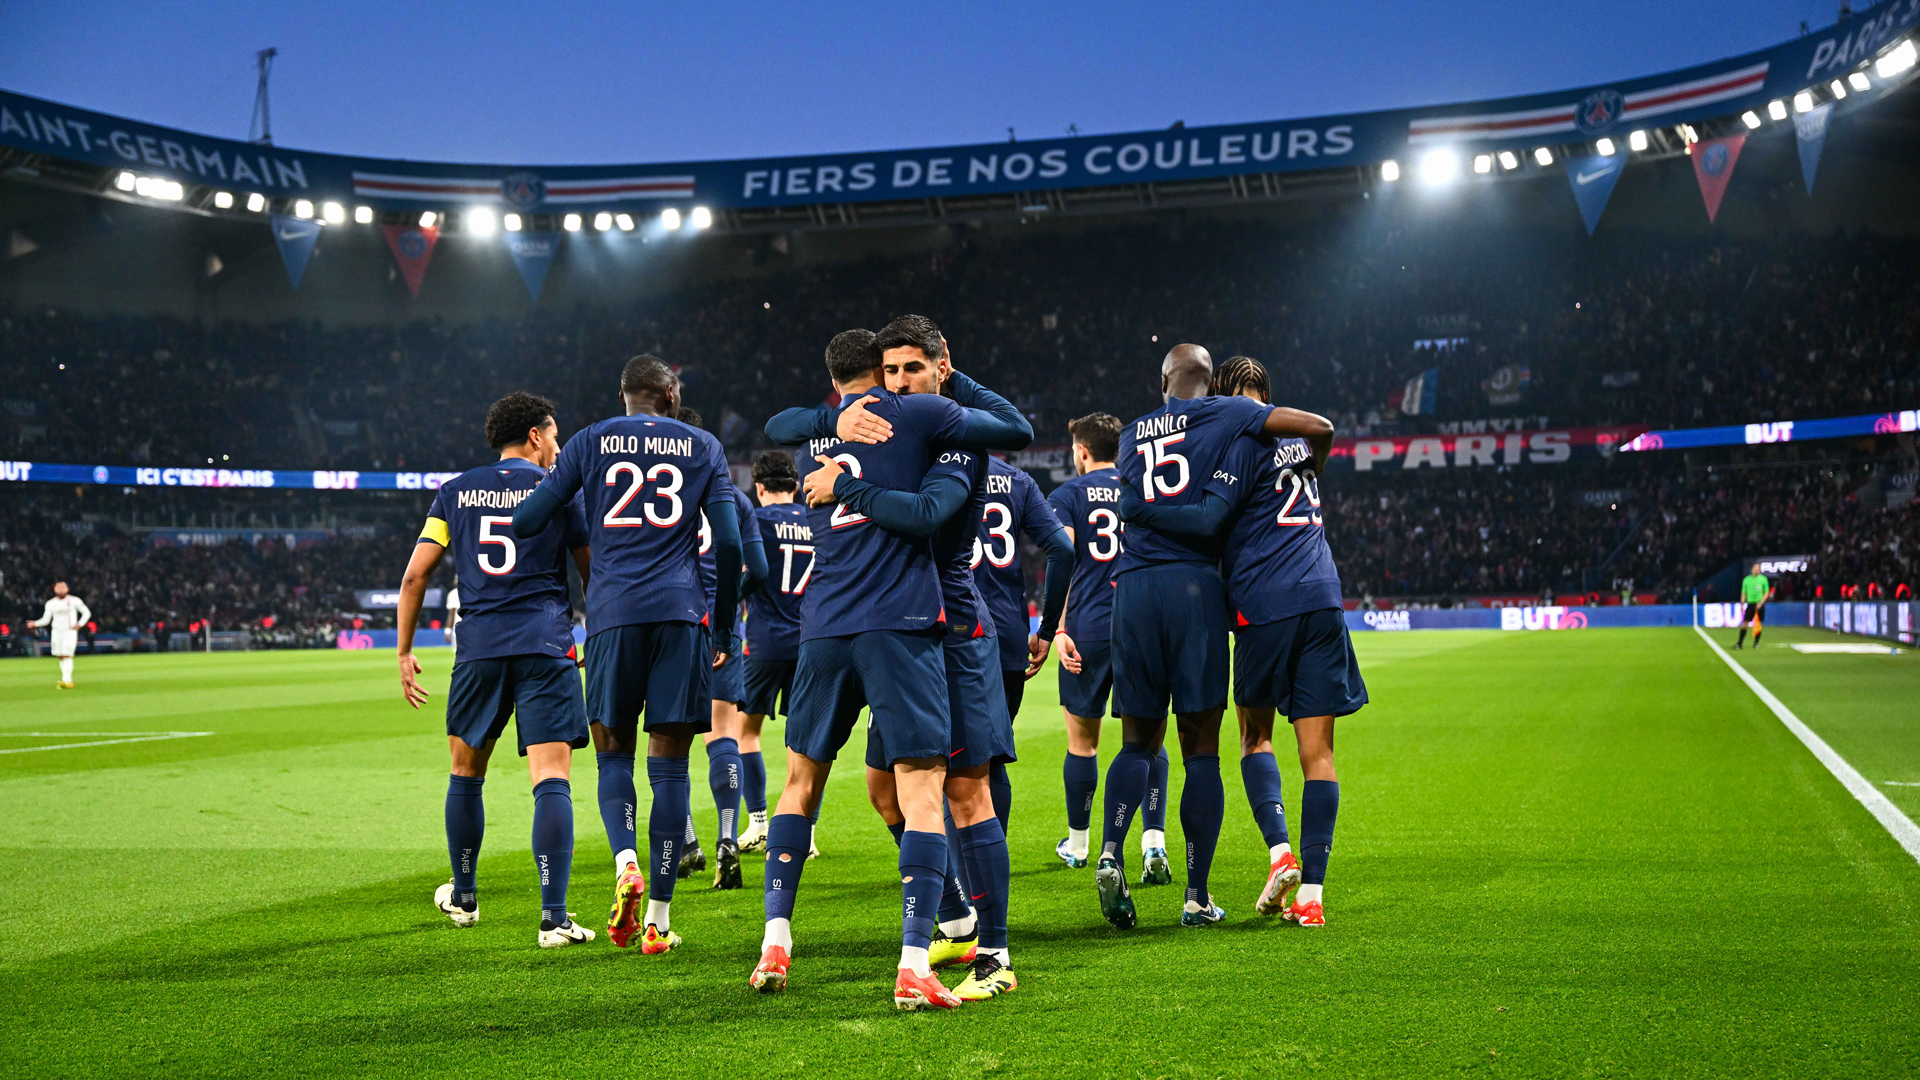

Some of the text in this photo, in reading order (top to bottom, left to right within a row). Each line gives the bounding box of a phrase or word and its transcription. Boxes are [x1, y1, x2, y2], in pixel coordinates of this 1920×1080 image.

[743, 124, 1355, 199] FIERS DE NOS COULEURS
[1136, 414, 1188, 440] DANILO
[1745, 421, 1794, 444] BUT
[600, 435, 692, 457] KOLO MUANI
[936, 452, 971, 466] OAT
[1355, 432, 1571, 471] PARIS
[217, 469, 275, 488] PARIS
[313, 470, 359, 489] BUT
[1136, 432, 1190, 502] 15
[1213, 469, 1238, 486] OAT
[457, 487, 535, 509] MARQUINH
[603, 461, 683, 528] 23
[477, 515, 517, 576] 5
[779, 543, 816, 595] 17
[1501, 606, 1562, 630] BUT
[727, 763, 738, 789] PARIS
[1149, 788, 1159, 811] PARIS
[624, 802, 634, 831] PARIS
[1114, 802, 1127, 828] PARIS
[461, 848, 471, 874] PARIS
[538, 854, 550, 886] PARIS
[660, 839, 673, 875] PARIS
[905, 896, 916, 918] PAR
